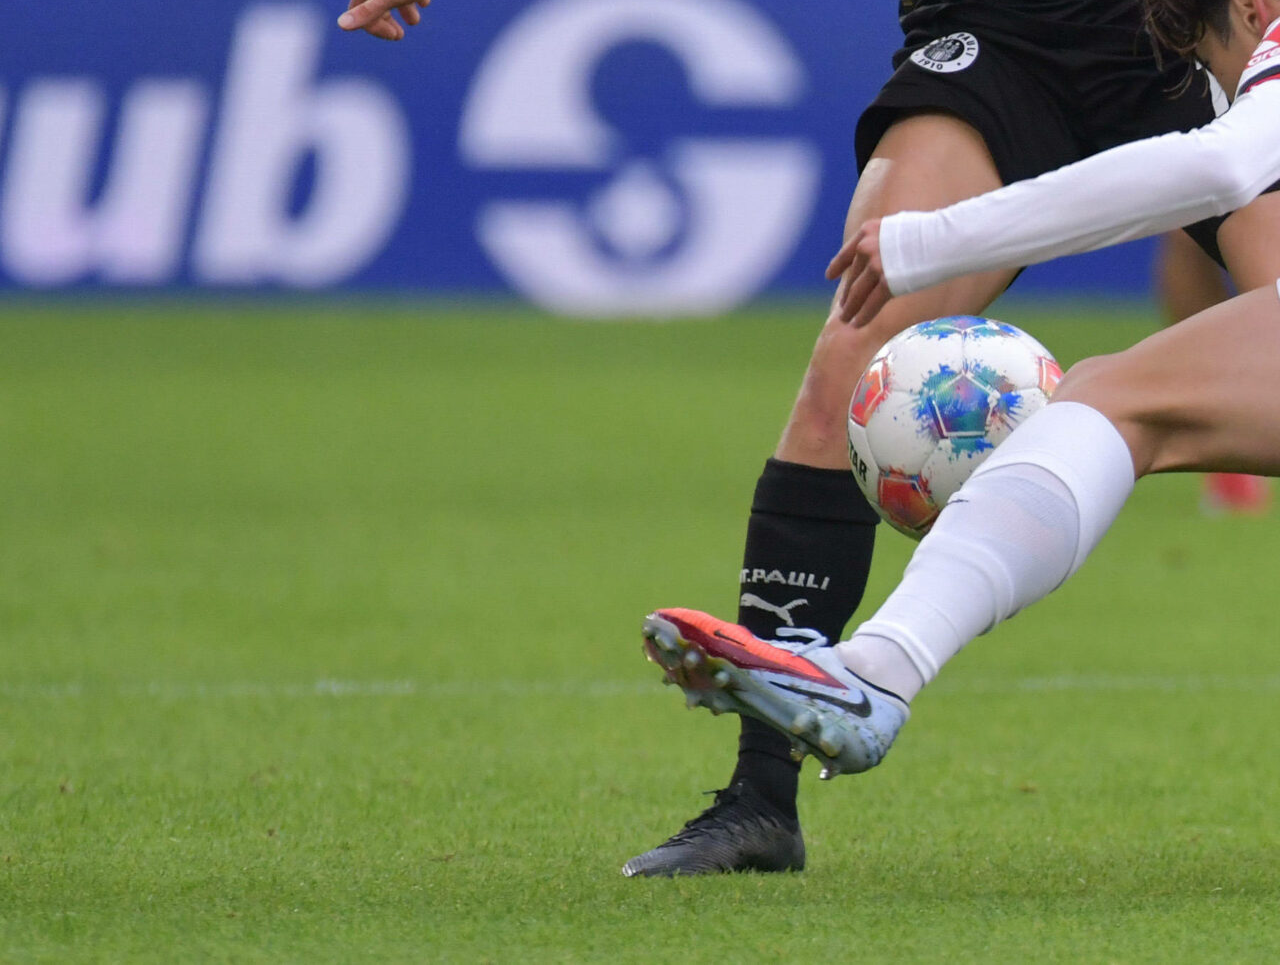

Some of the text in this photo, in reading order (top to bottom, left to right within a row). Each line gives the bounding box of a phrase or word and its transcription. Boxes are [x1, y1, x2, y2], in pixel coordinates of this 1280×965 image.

[918, 58, 943, 70] 1910
[0, 0, 412, 289] ub
[741, 568, 830, 590] T.PAULI
